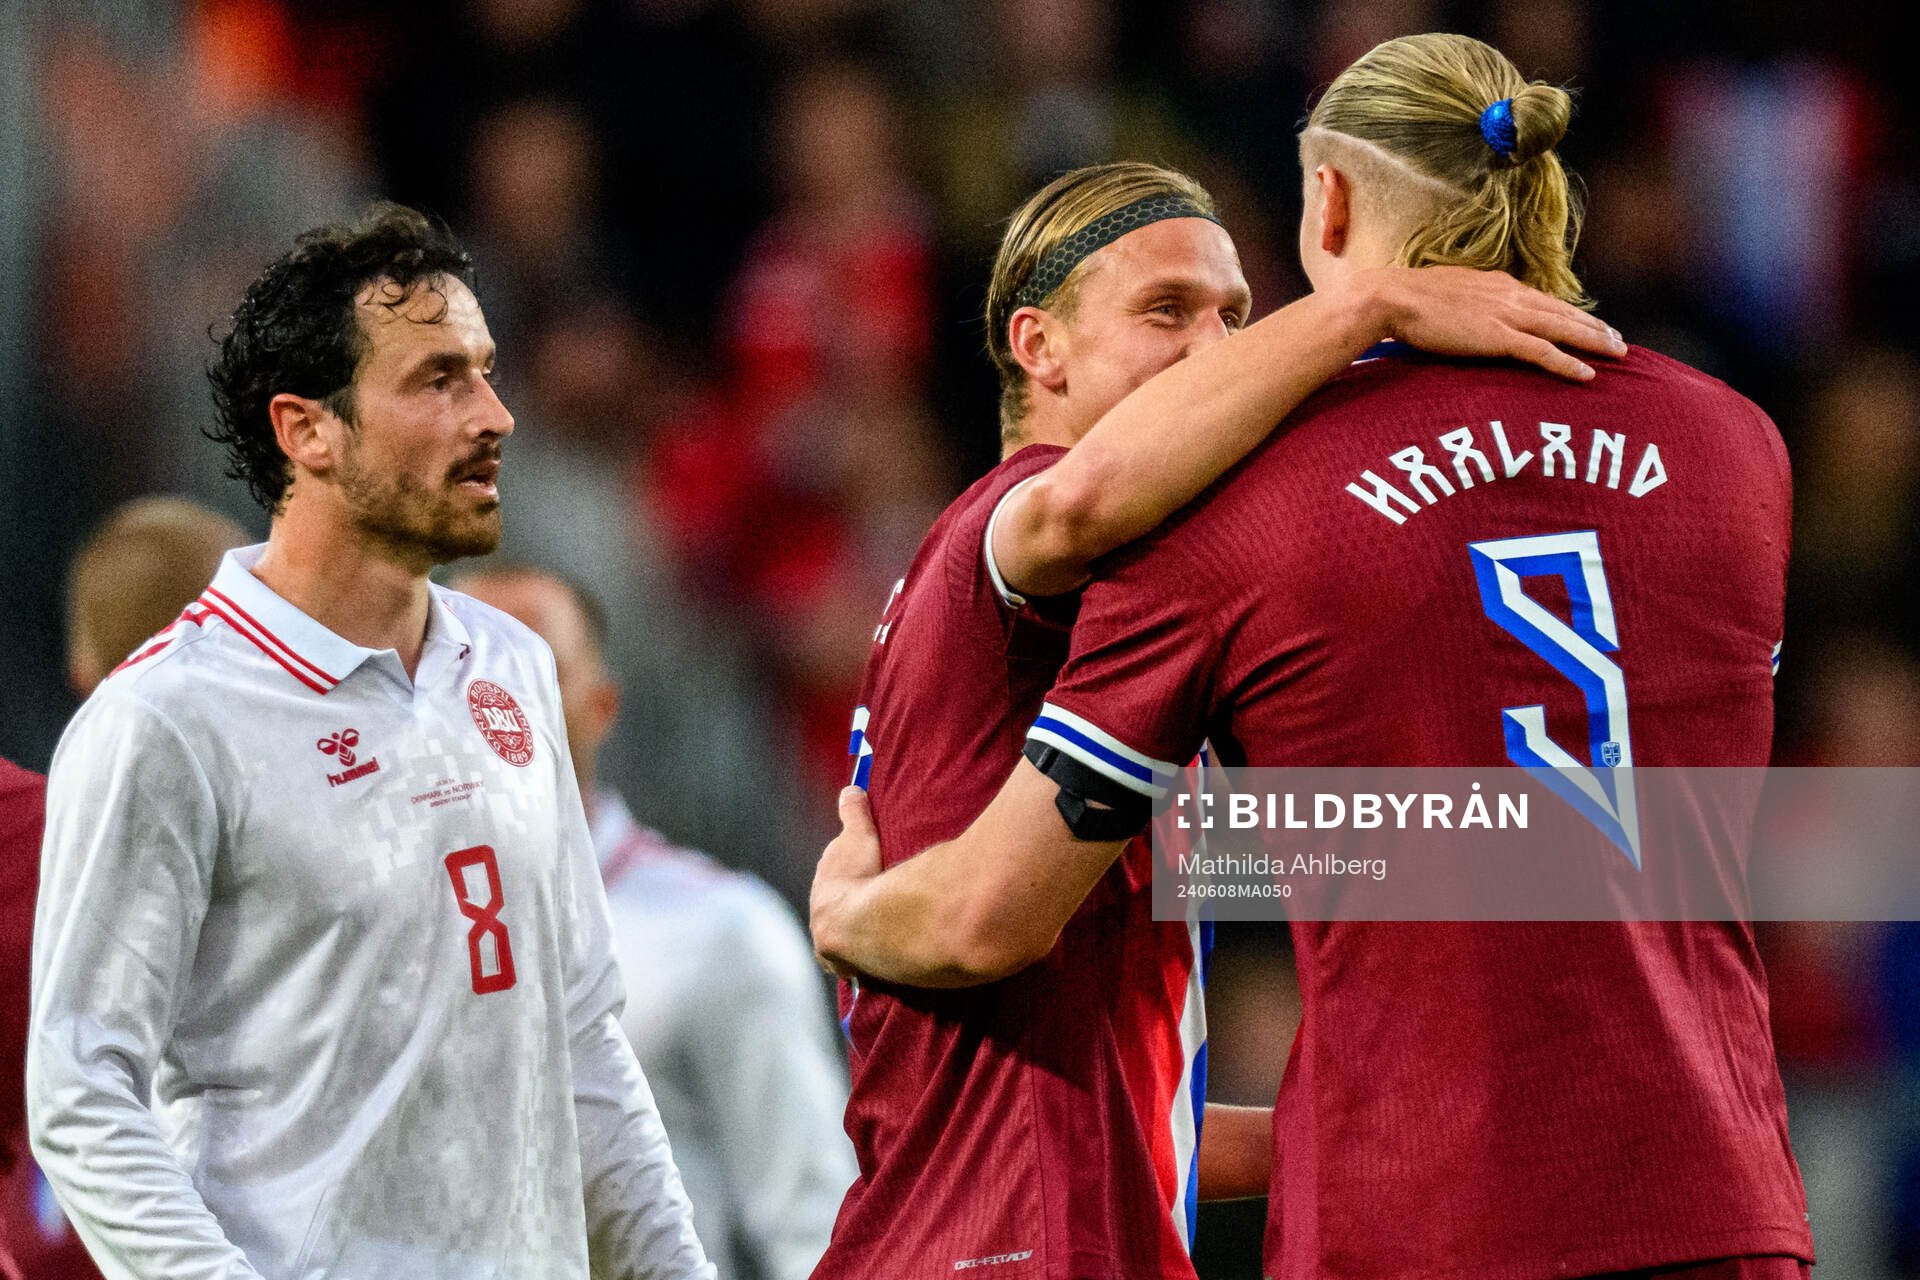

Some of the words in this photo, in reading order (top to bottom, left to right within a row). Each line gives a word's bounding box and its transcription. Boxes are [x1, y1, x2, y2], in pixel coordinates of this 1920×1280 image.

[1345, 421, 1668, 525] HAALAND
[481, 706, 523, 732] DBU
[1468, 529, 1641, 872] 9
[327, 756, 380, 787] hummel
[505, 751, 529, 763] 1889
[444, 845, 517, 994] 8
